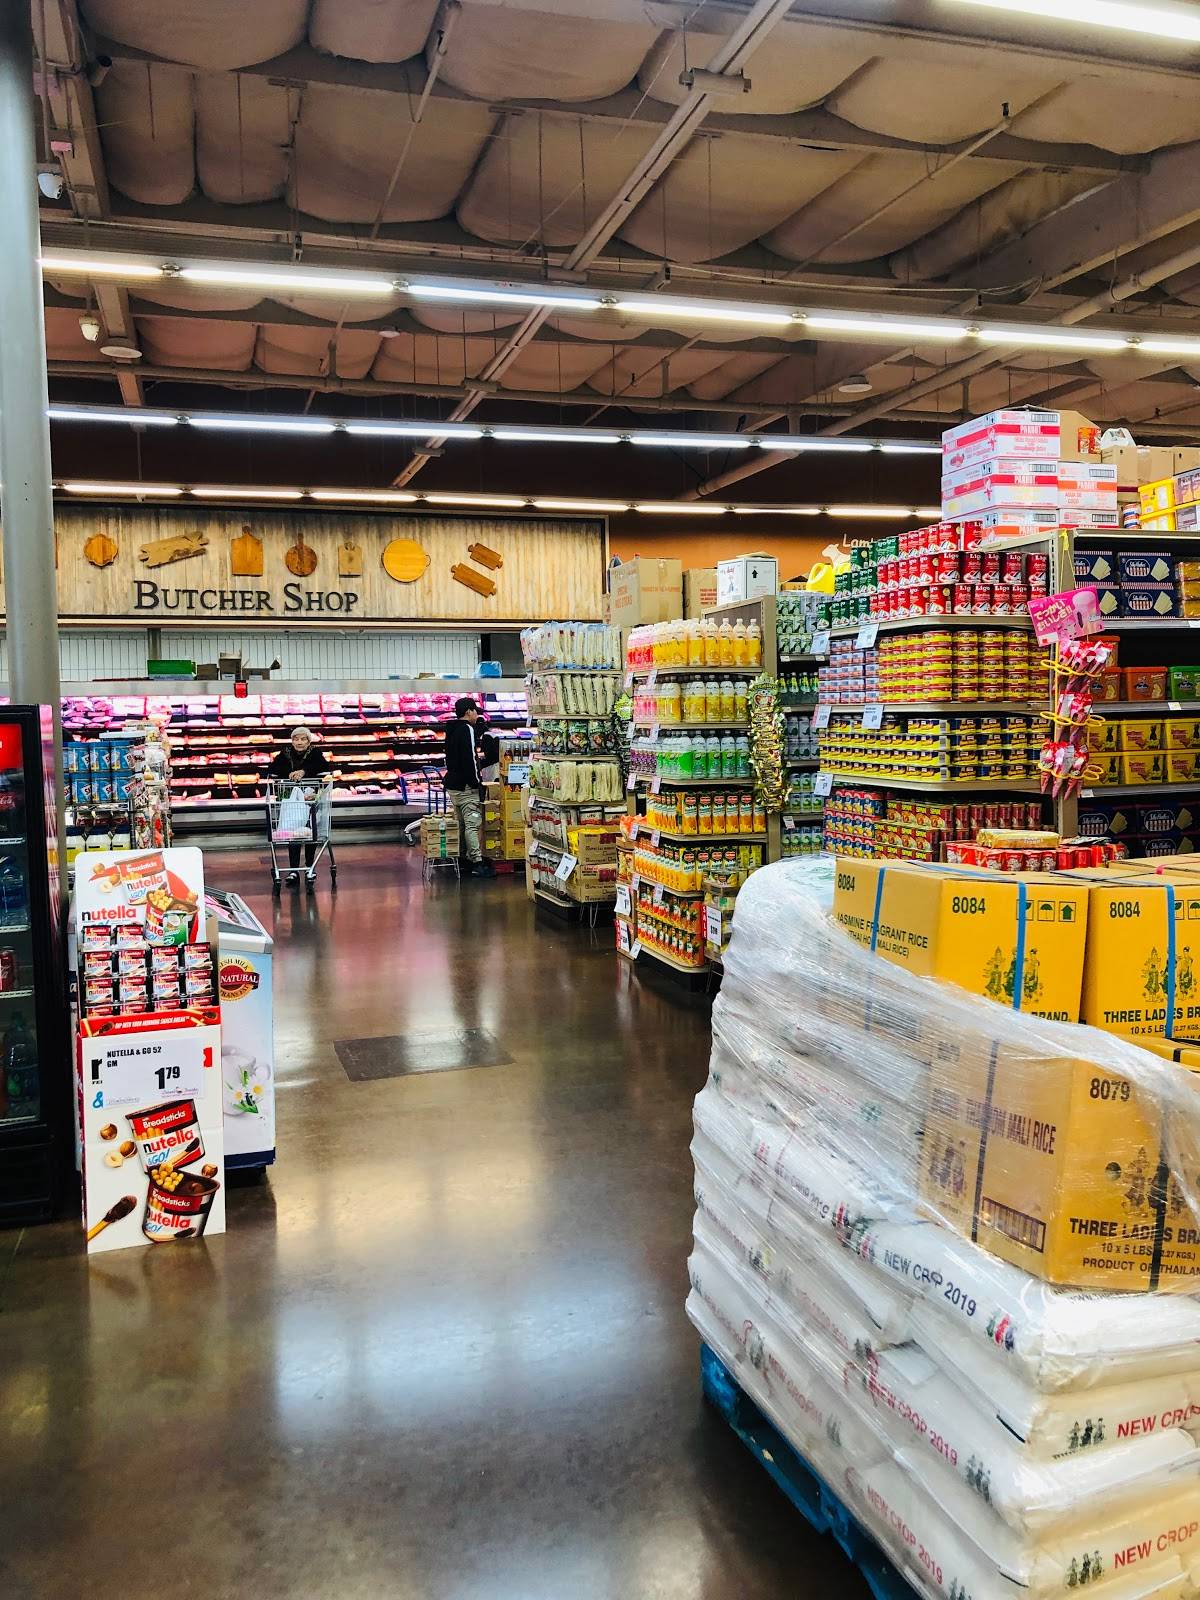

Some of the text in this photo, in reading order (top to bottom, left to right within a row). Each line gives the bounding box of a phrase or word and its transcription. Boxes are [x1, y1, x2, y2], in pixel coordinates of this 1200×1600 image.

[843, 534, 874, 548] Lam
[134, 579, 359, 612] BUTCHER SHOP
[127, 875, 163, 890] nutella
[837, 873, 856, 893] 8084
[82, 905, 136, 921] nutella
[952, 896, 986, 915] 8084
[1109, 901, 1141, 919] 8084
[146, 920, 164, 936] nute
[908, 933, 929, 949] RICE
[220, 973, 258, 984] NATURAL
[1104, 1010, 1142, 1024] THREE
[1145, 1008, 1184, 1022] LADES
[1147, 1026, 1153, 1034] 5
[107, 1048, 135, 1058] NUTELLA
[142, 1047, 152, 1055] GO
[153, 1046, 162, 1054] 52
[107, 1060, 118, 1068] GM
[1089, 1077, 1130, 1102] 8079
[142, 1110, 187, 1129] Breadsticks
[143, 1129, 195, 1154] nutella
[1032, 1120, 1057, 1155] RICE
[152, 1189, 191, 1207] Breadsticks
[147, 1209, 191, 1228] nutella
[1069, 1217, 1118, 1237] THREE
[1122, 1223, 1173, 1243] LADIS
[1101, 1242, 1113, 1253] 10
[1083, 1257, 1135, 1271] PRODUCT
[884, 1249, 911, 1275] NEW
[944, 1281, 977, 1317] 2019
[1117, 1415, 1157, 1438] NEW
[929, 1429, 958, 1467] 2019
[890, 1510, 916, 1546] CROP
[918, 1544, 943, 1584] 2019
[1114, 1522, 1199, 1568] NEW CROP
